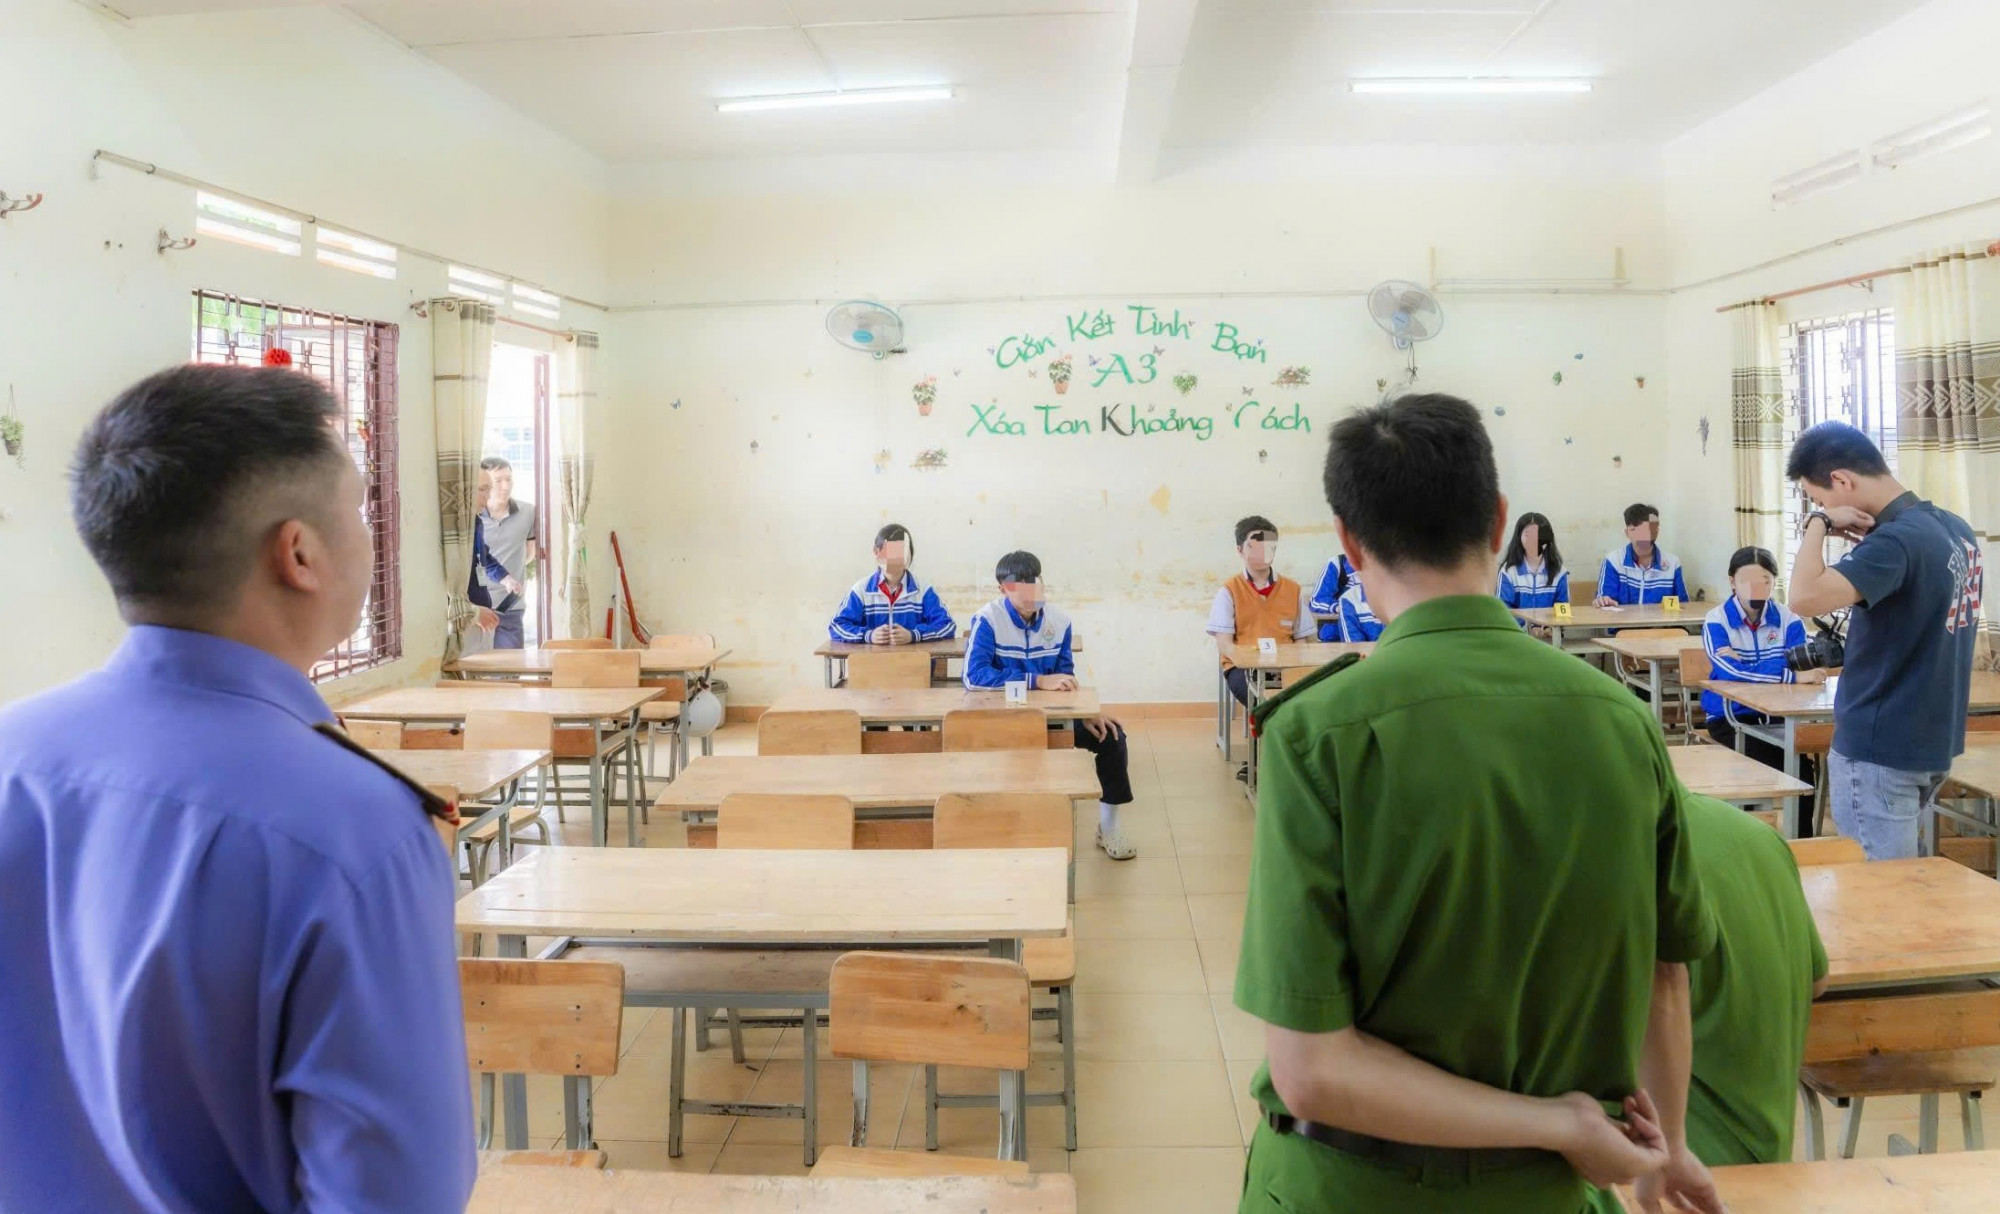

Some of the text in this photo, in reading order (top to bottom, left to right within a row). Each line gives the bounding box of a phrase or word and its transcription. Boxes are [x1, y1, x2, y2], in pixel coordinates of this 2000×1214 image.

[1066, 309, 1115, 342] Kết
[1127, 305, 1189, 340] Tình
[1211, 321, 1266, 363] Bạn
[1089, 352, 1159, 388] A3
[966, 403, 1026, 438] Xóa
[1033, 404, 1091, 435] Tan
[1101, 403, 1214, 441] Khoảng
[1559, 605, 1566, 614] 6
[1668, 598, 1674, 607] 7
[1263, 641, 1271, 650] 3
